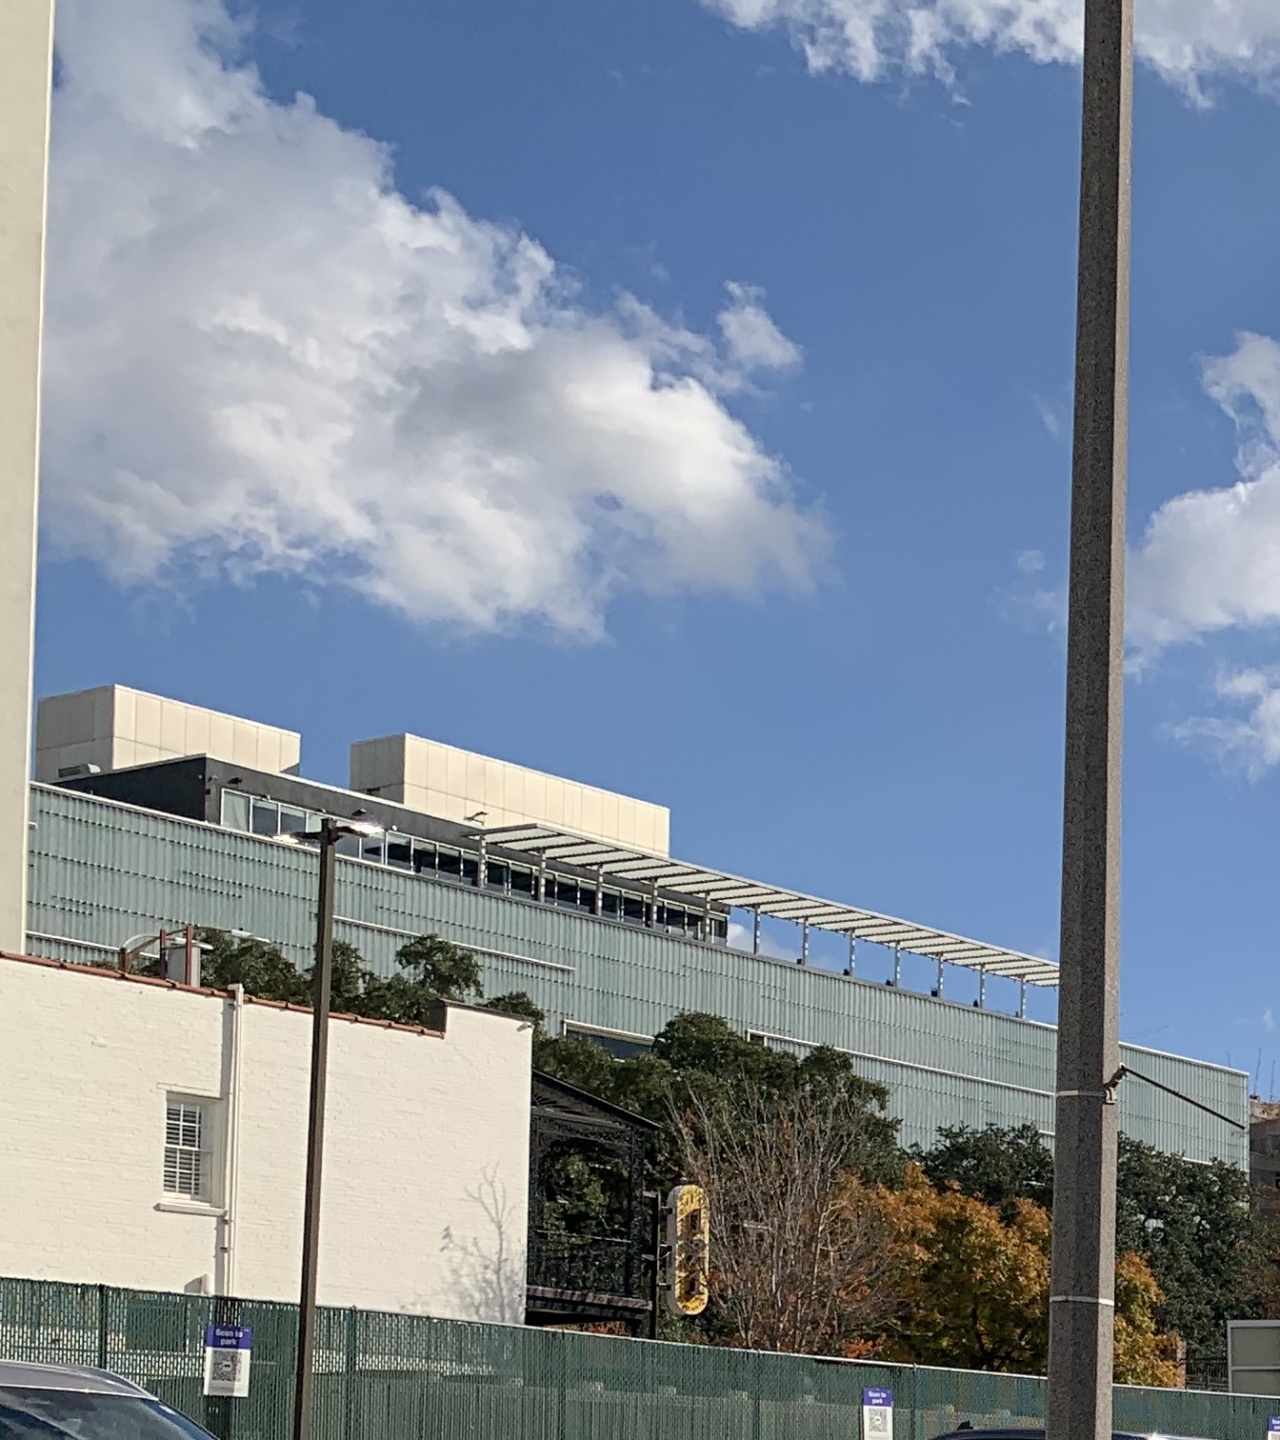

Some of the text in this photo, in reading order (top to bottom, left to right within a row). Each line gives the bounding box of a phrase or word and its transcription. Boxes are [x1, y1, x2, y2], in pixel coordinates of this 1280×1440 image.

[215, 1328, 243, 1338] Scan to
[220, 1338, 237, 1346] park
